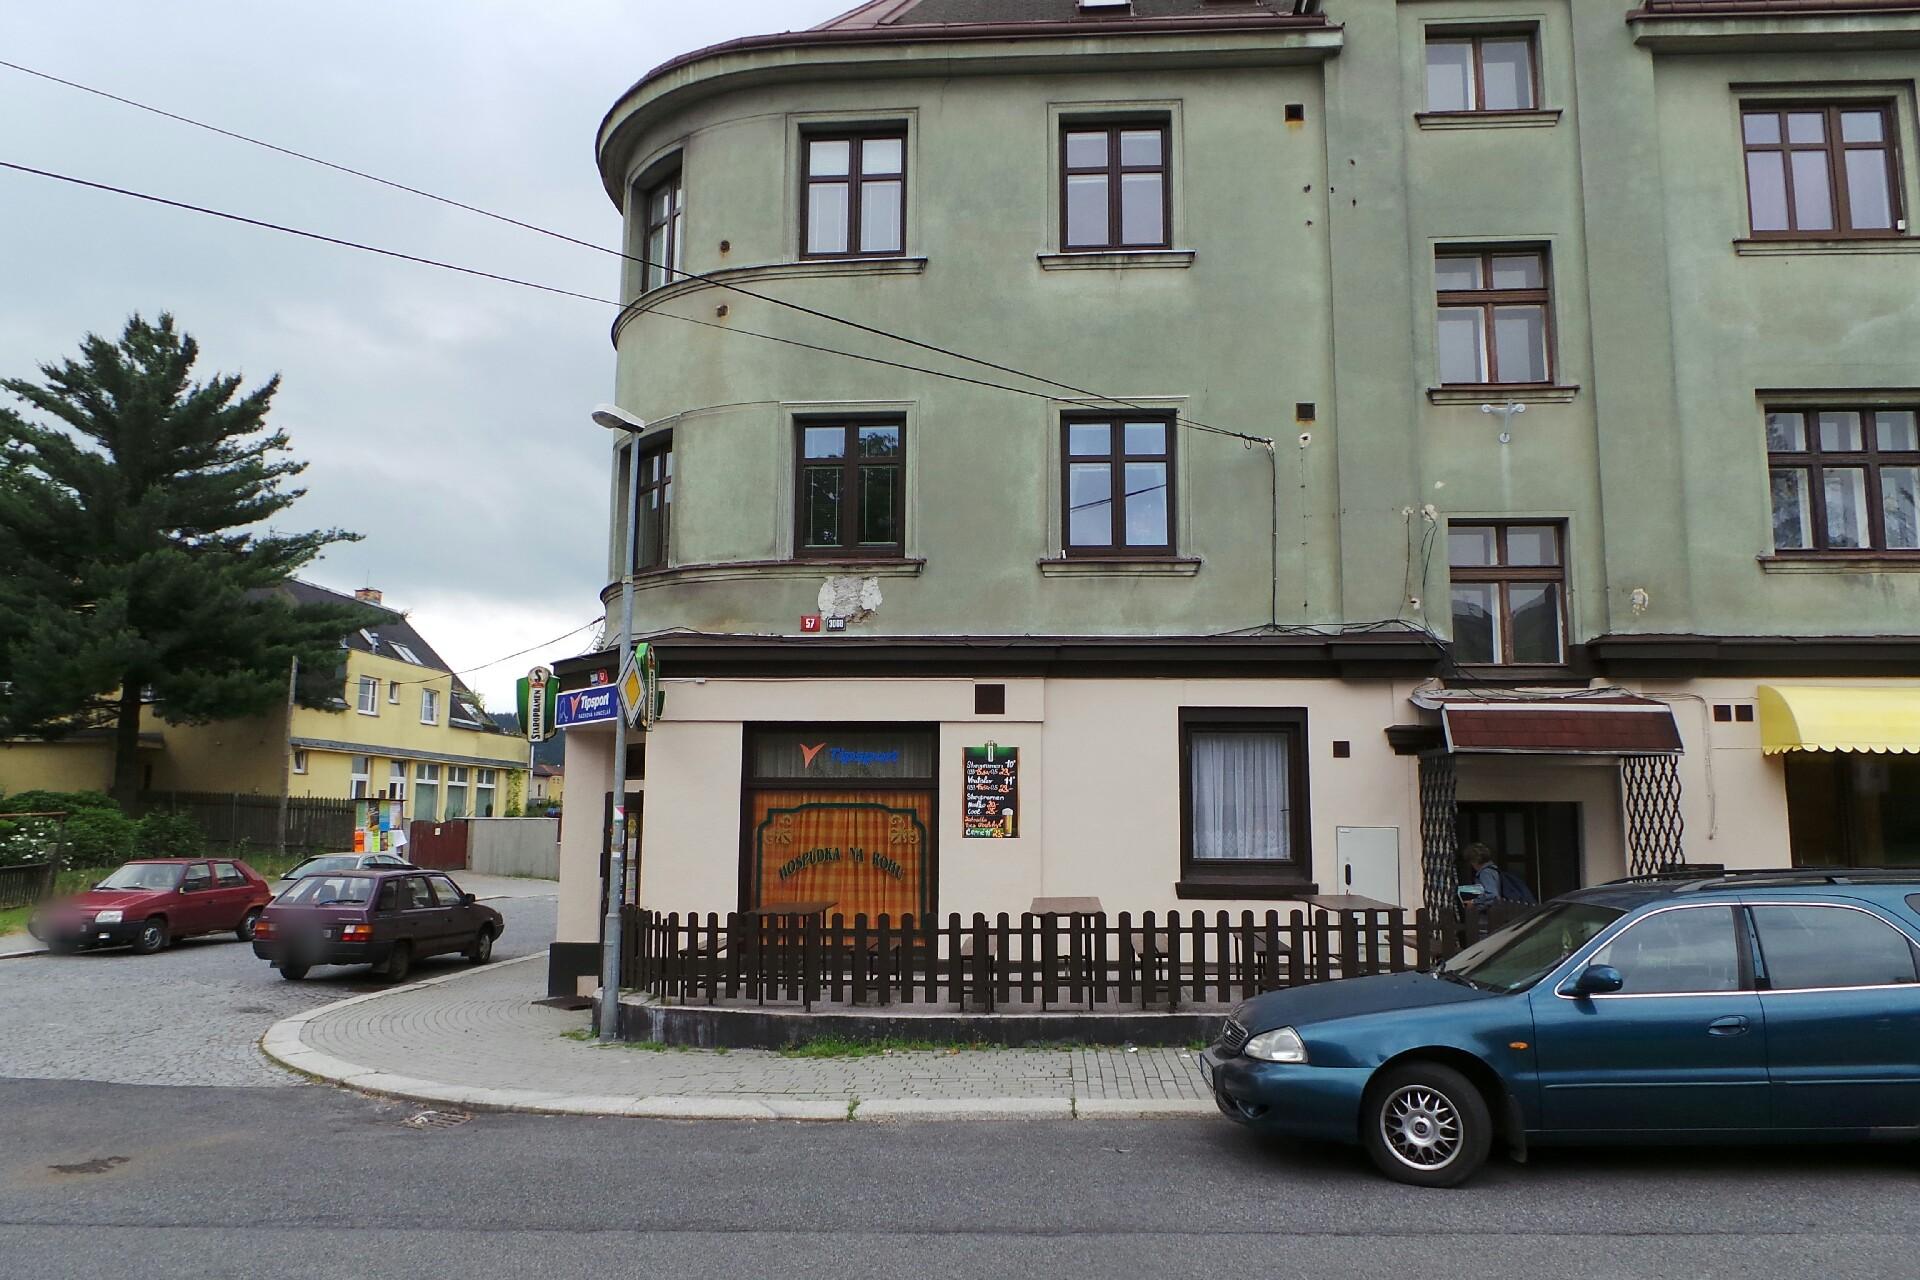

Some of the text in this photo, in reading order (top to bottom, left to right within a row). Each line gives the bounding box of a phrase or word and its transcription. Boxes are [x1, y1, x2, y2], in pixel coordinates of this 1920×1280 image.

[805, 618, 815, 628] 57
[581, 692, 610, 711] Tipsport
[531, 689, 542, 740] STAROPRAMEN
[849, 847, 864, 863] NA
